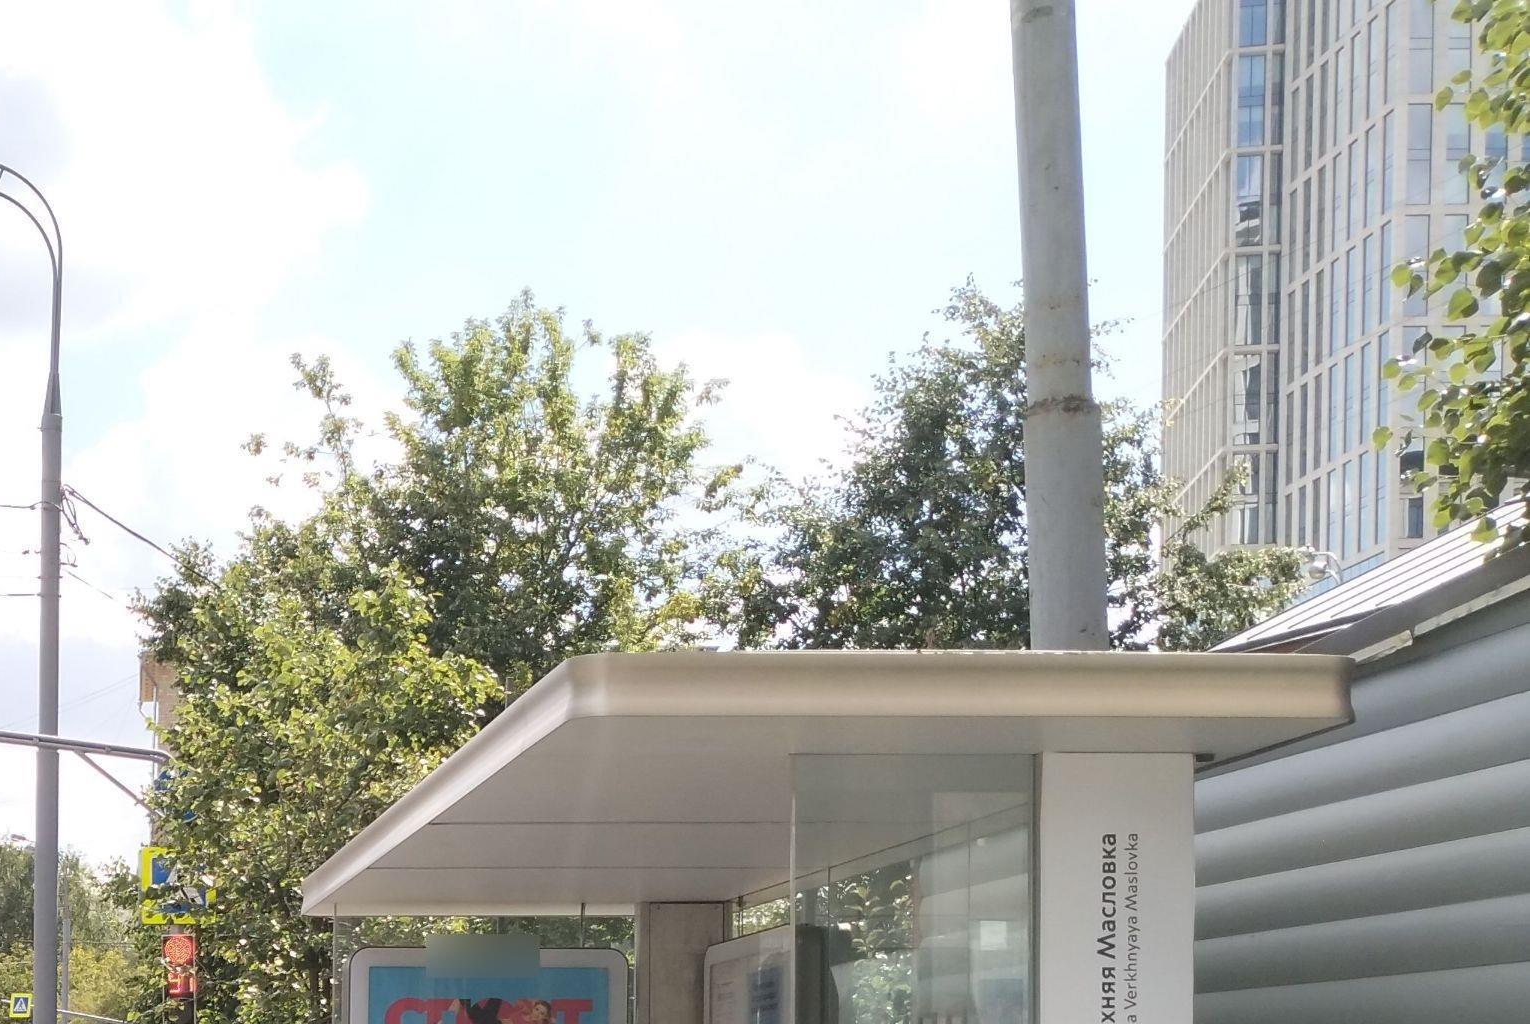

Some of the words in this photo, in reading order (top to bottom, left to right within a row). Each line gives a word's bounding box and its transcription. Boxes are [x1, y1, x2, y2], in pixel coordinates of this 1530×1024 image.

[1096, 833, 1118, 959] Масловка
[1123, 833, 1139, 911] Maslovka
[1123, 915, 1141, 1011] Verkhnyaya
